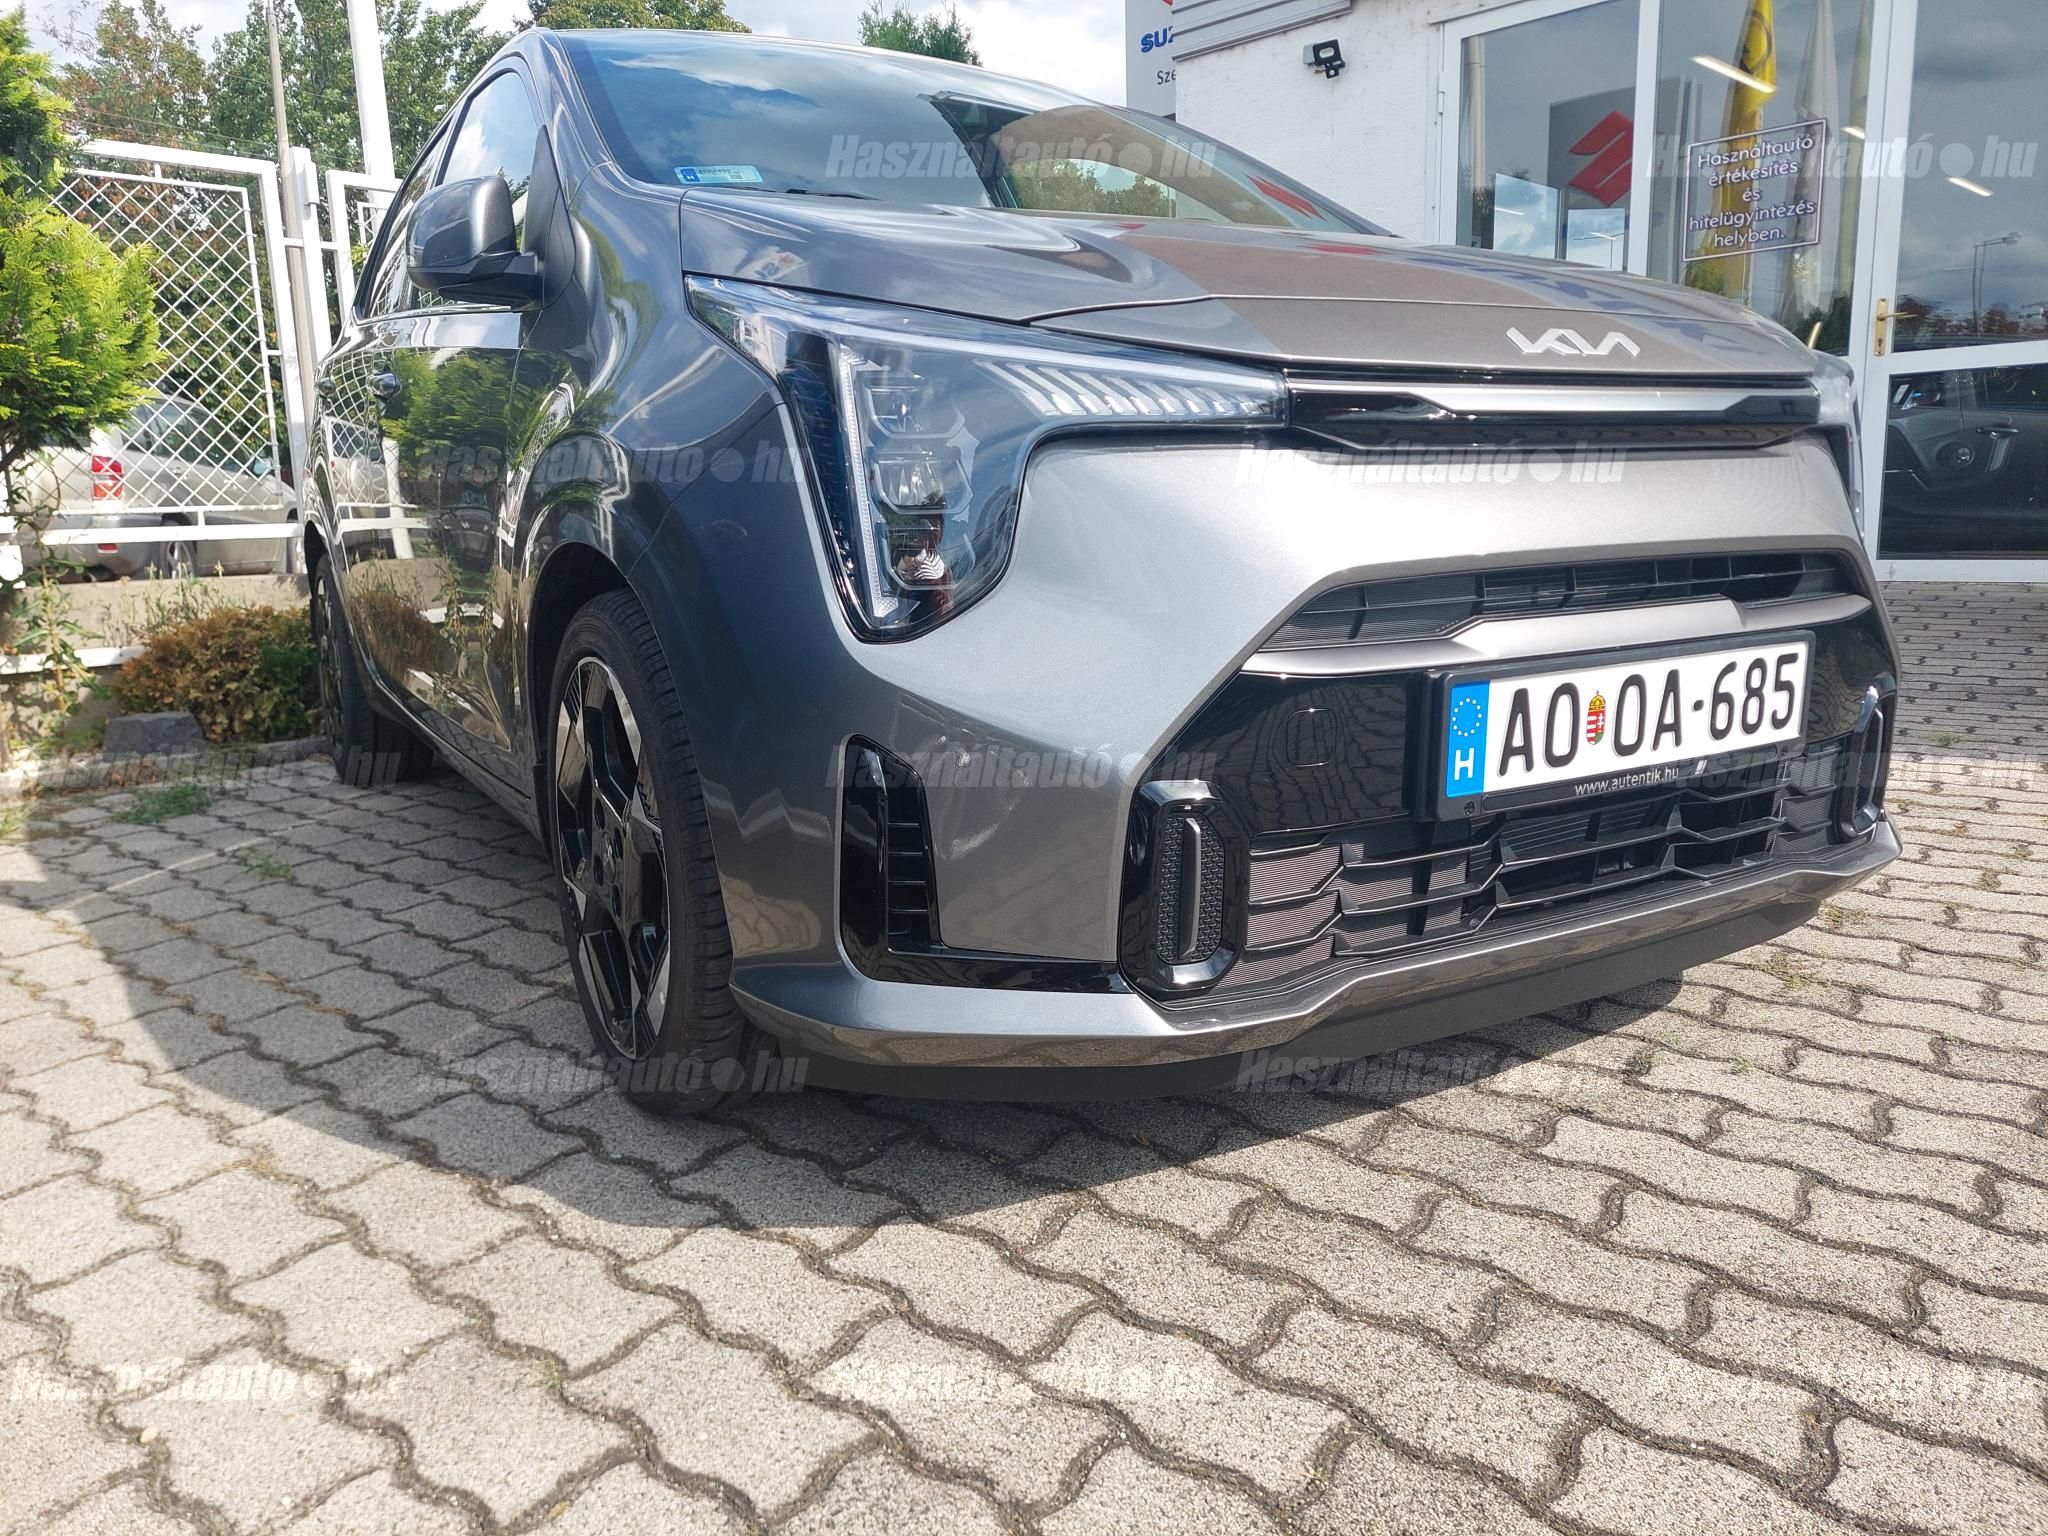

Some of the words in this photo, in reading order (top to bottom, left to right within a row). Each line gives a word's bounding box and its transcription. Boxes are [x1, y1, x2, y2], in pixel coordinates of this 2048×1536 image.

[1697, 135, 1814, 168] Használtautó
[1708, 160, 1798, 187] értékesítés
[1742, 188, 1761, 201] és
[1689, 200, 1816, 231] hitelügyintézés
[1714, 228, 1785, 247] helyben.
[1454, 747, 1476, 781] H
[1574, 766, 1679, 796] www.autentik.hu
